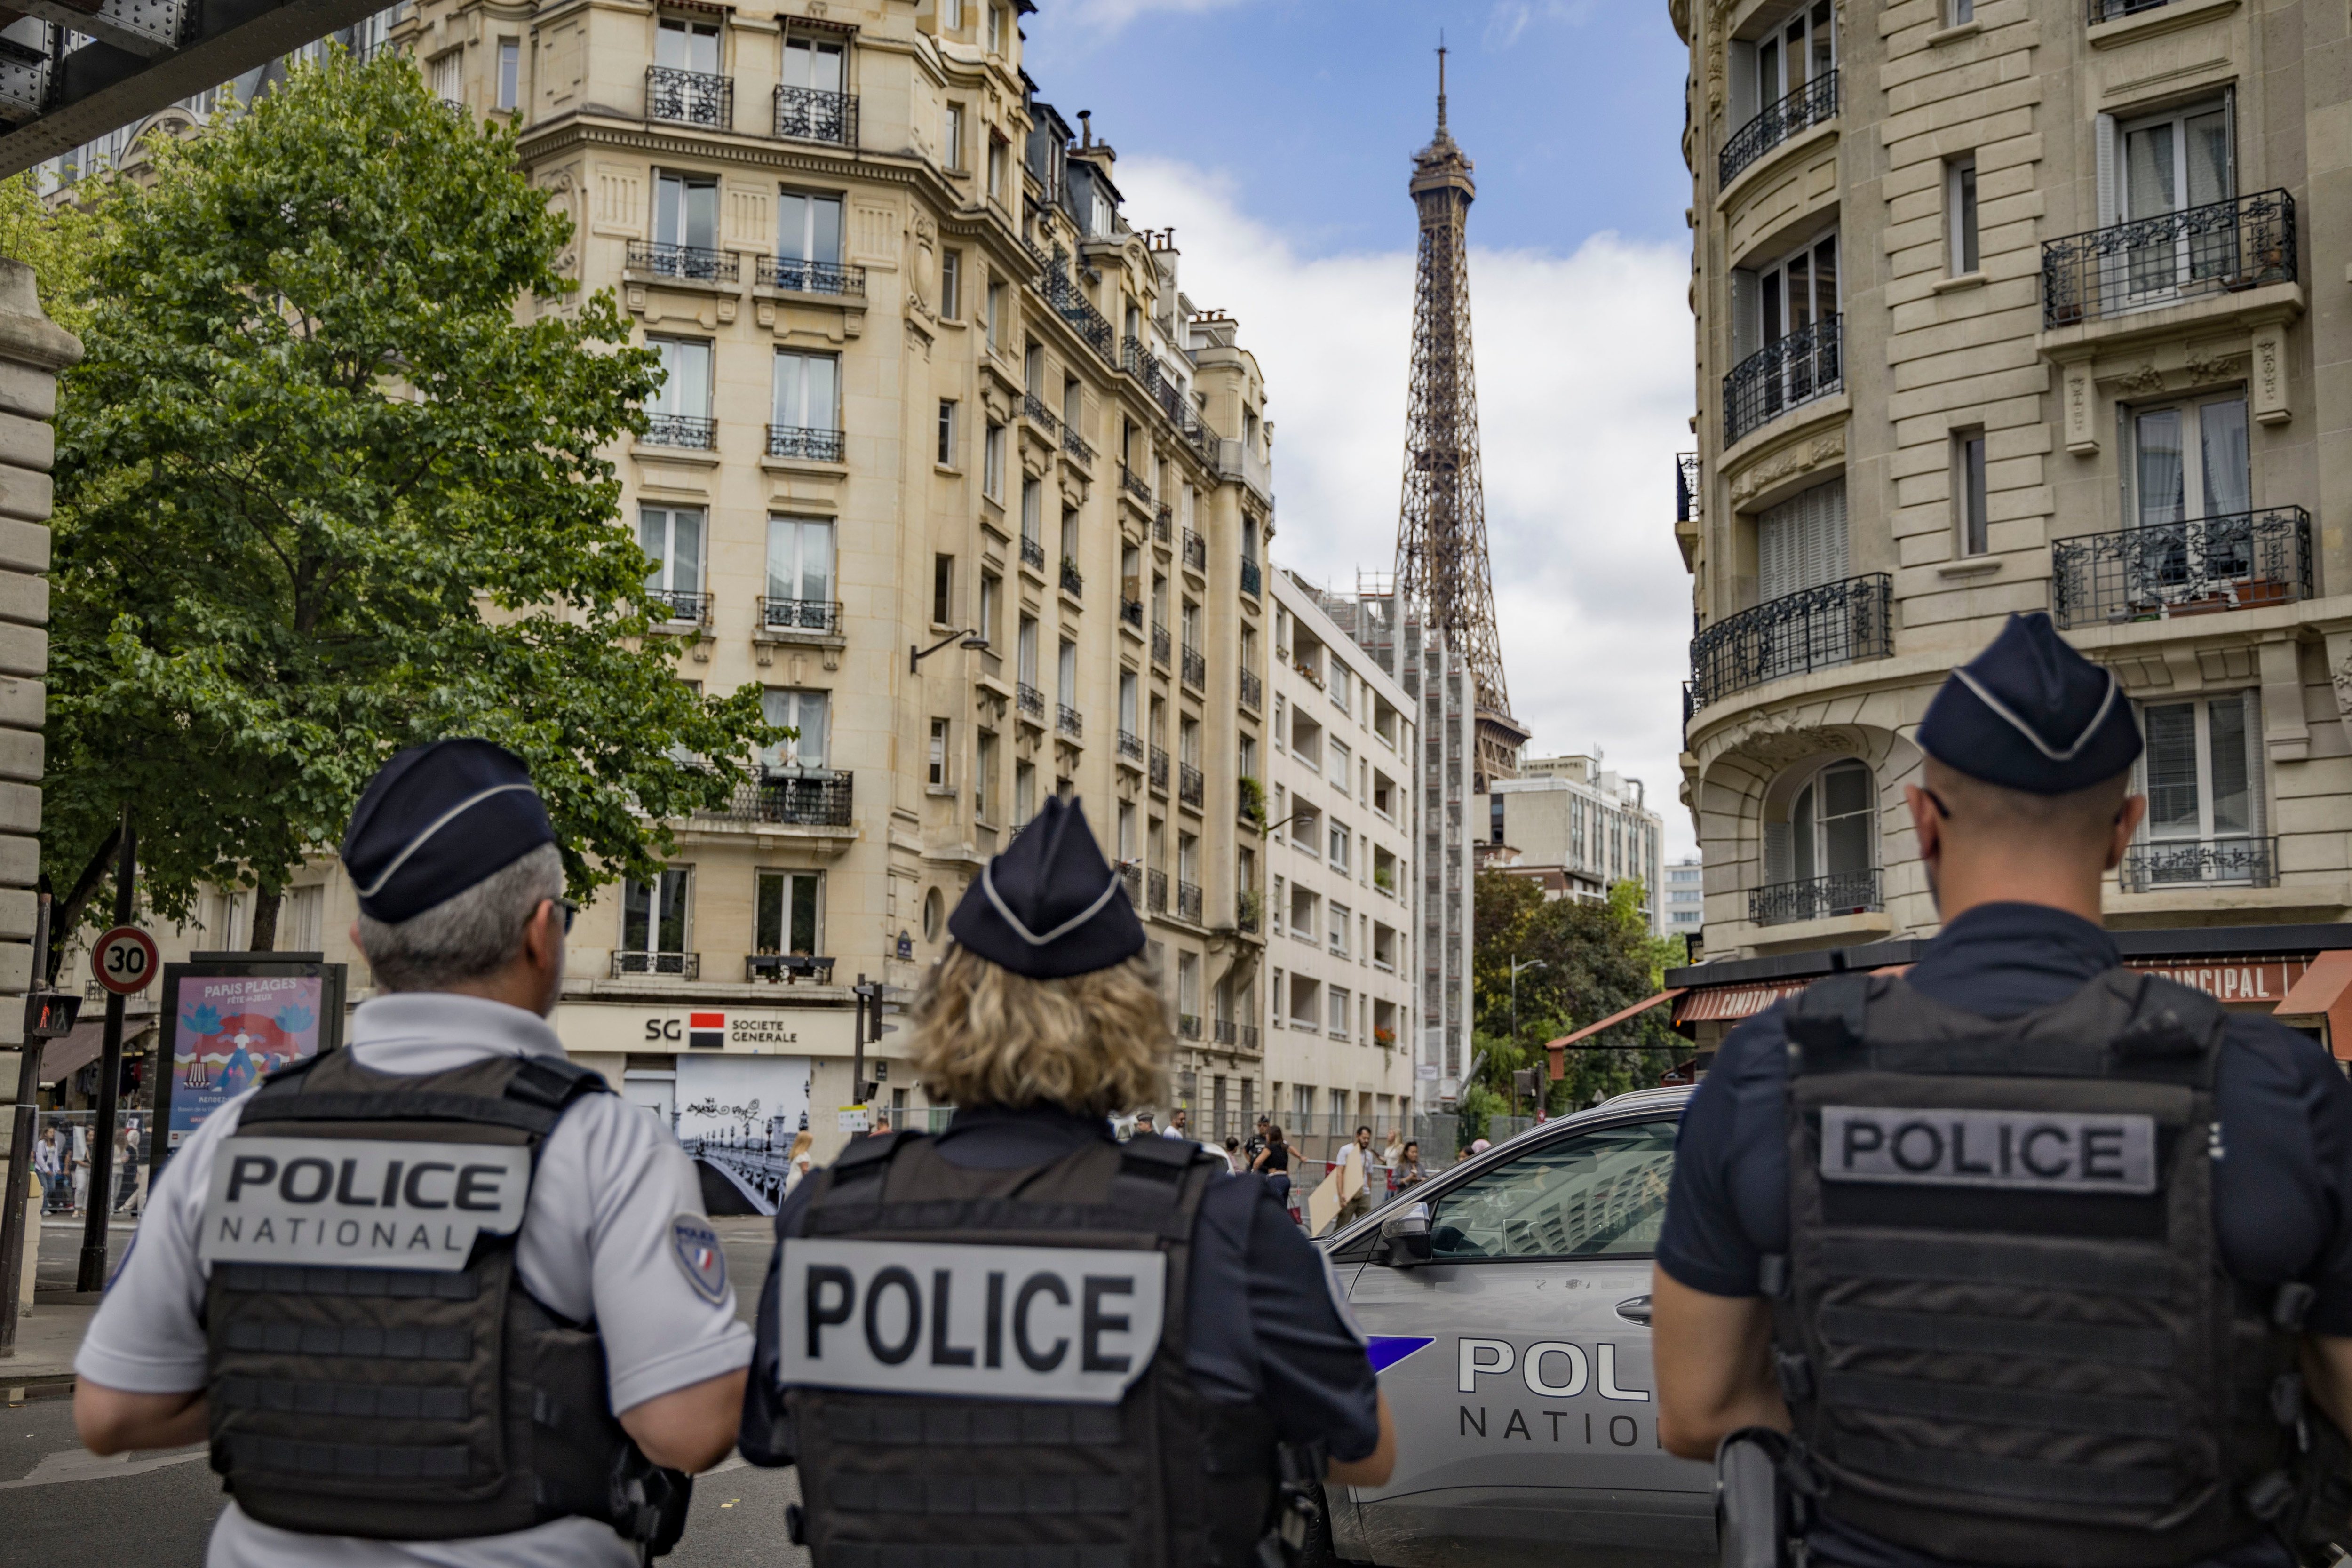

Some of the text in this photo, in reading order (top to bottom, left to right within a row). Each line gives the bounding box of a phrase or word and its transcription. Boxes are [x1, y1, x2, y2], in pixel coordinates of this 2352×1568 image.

[108, 946, 144, 974] 30
[205, 978, 296, 998] PARIS PLAGES
[2143, 968, 2269, 998] NCIPAL
[253, 993, 272, 1002] JEUX
[645, 1019, 681, 1040] SG
[732, 1020, 784, 1030] SOCIETE
[732, 1033, 797, 1043] GENERALE
[1843, 1121, 2124, 1179] POLICE
[226, 1155, 507, 1212] POLICE
[806, 1264, 1134, 1372] POLICE
[1460, 1405, 1662, 1449] NATIO
